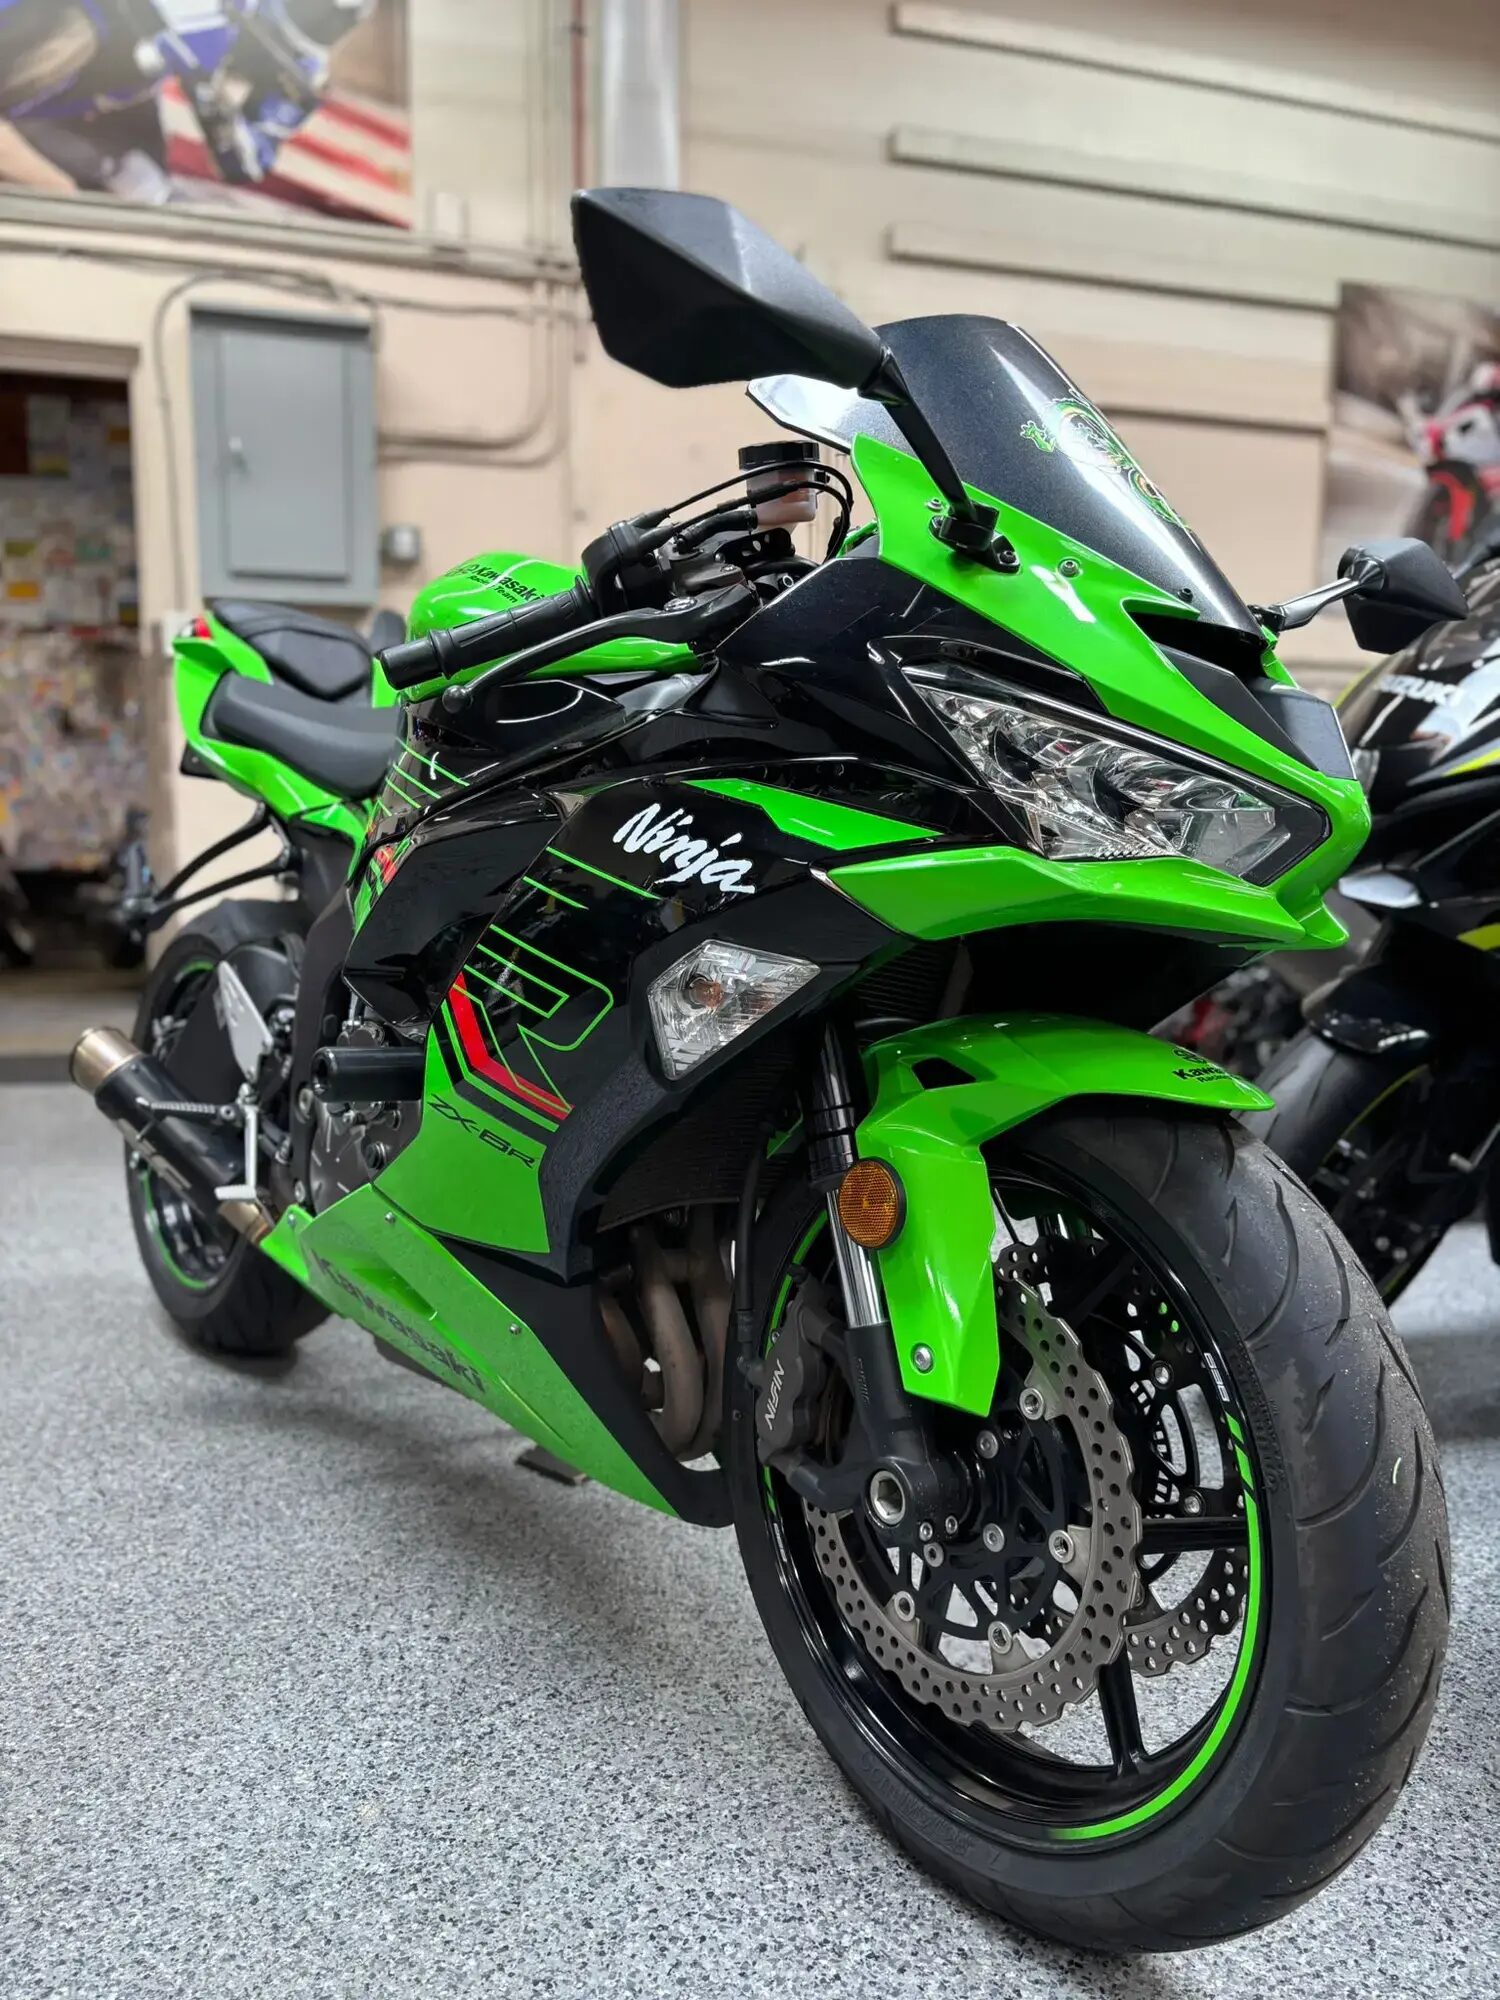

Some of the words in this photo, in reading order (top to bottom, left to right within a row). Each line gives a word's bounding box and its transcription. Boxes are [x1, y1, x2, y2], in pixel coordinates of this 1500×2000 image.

[494, 585, 518, 603] Team
[612, 803, 756, 894] Ninja
[428, 1093, 535, 1169] ZX-6R
[311, 1249, 486, 1393] Kawasaki
